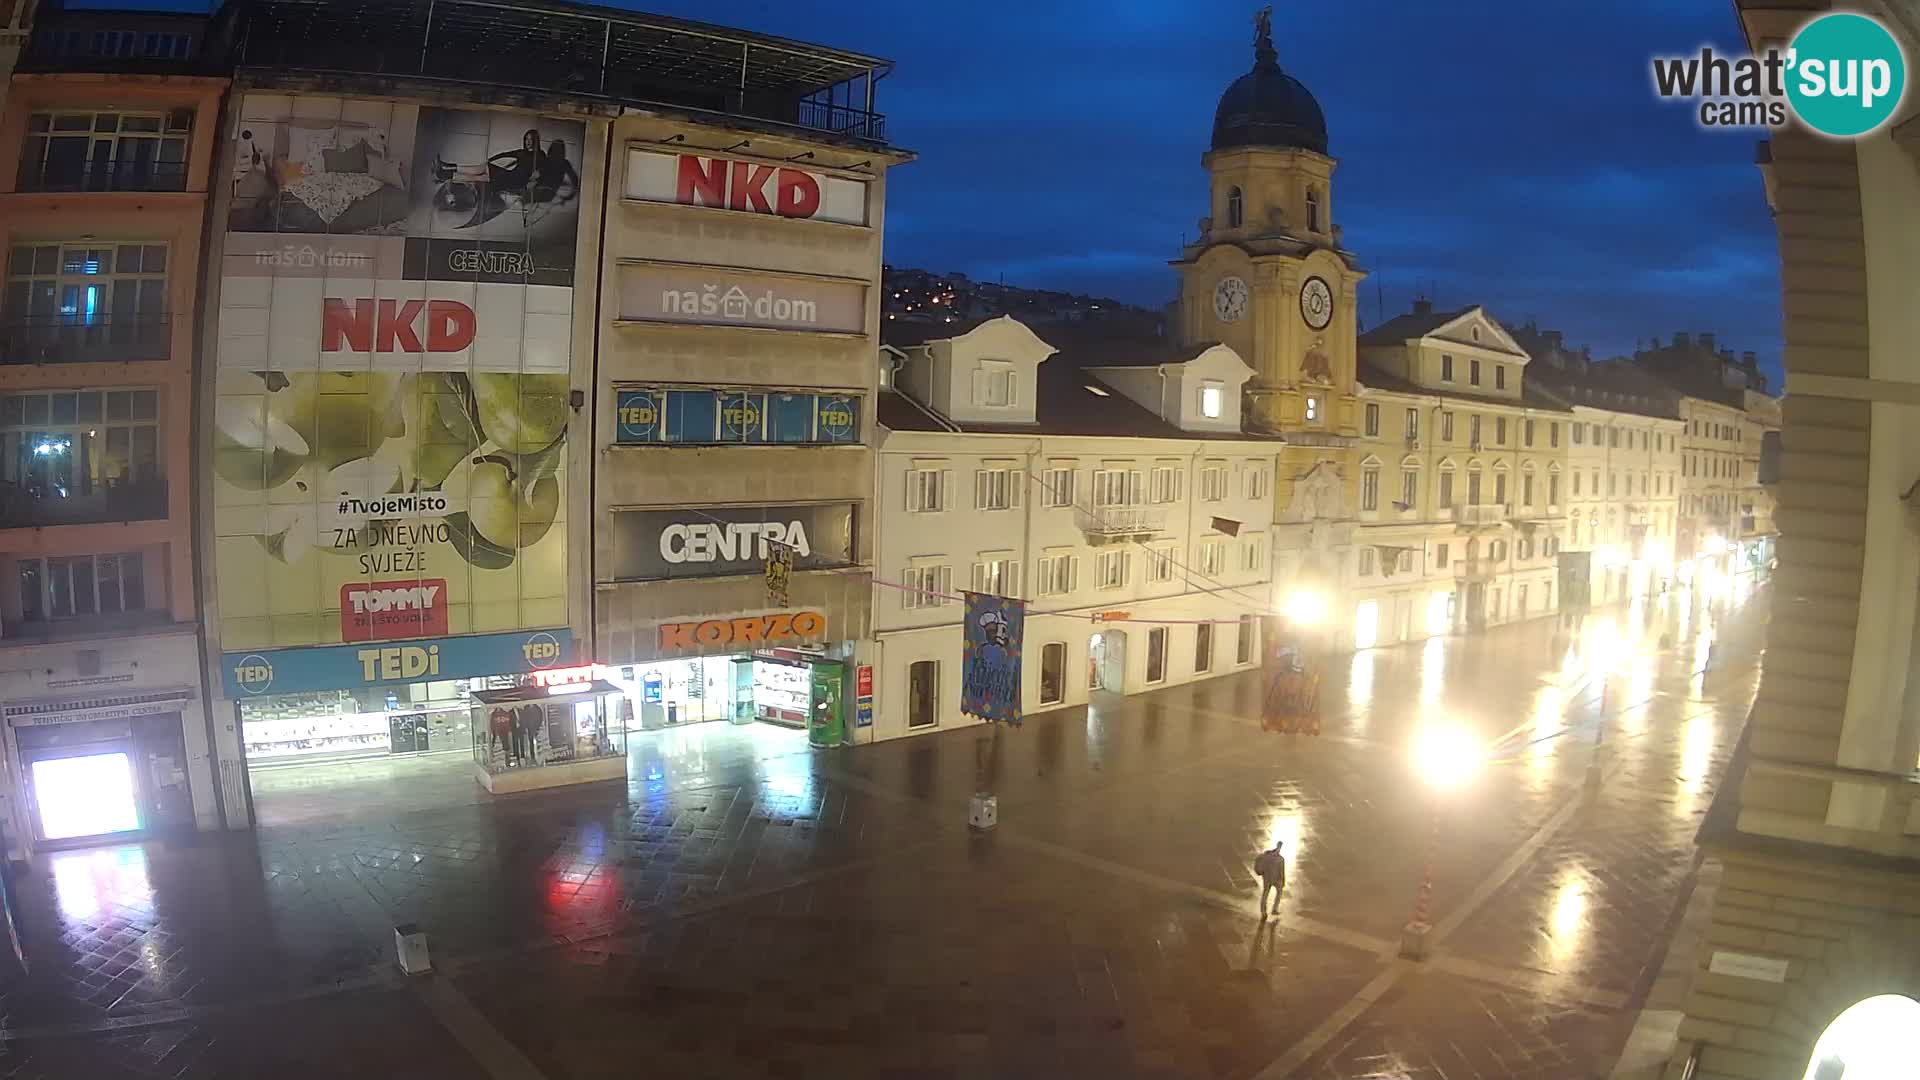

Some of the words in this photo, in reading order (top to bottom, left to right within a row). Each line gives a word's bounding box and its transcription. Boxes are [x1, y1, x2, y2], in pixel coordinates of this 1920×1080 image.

[677, 154, 820, 219] NKD
[449, 249, 535, 275] CENTRA
[662, 283, 719, 314] naš
[754, 290, 817, 322] dom
[321, 298, 477, 352] NKD
[619, 407, 658, 425] TEDi
[723, 408, 760, 425] TEDi
[820, 410, 853, 426] TEDi
[338, 496, 446, 515] #TvojeMisto
[333, 528, 358, 548] ZA
[368, 523, 450, 547] DNEVNO
[660, 520, 811, 563] CENTRA
[359, 546, 427, 574] SVJEŽE
[348, 586, 439, 614] TOMMY
[659, 611, 825, 650] KORZO
[358, 645, 439, 681] TEDi
[523, 642, 560, 660] TEDi
[234, 666, 273, 683] TEDi
